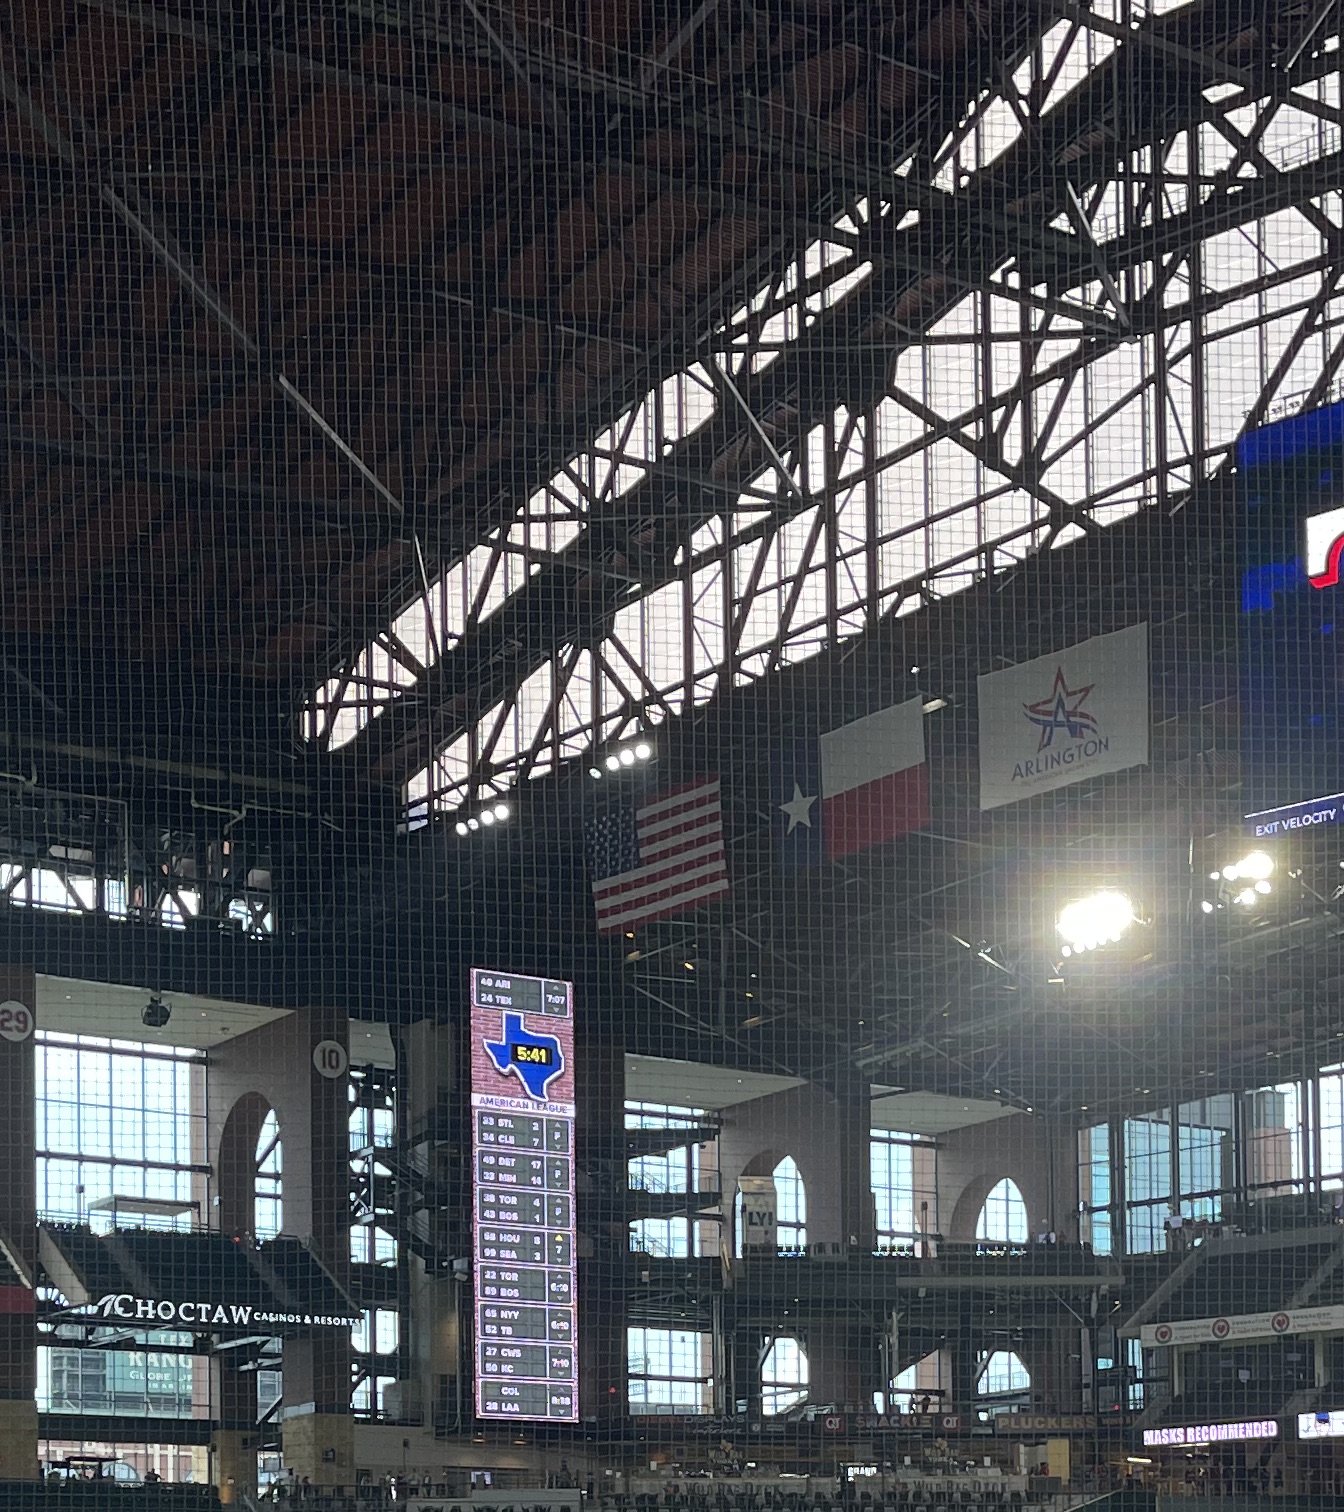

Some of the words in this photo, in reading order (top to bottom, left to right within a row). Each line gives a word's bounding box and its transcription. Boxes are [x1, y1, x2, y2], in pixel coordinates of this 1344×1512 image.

[1011, 736, 1109, 781] ARLINGTON
[1255, 820, 1279, 837] EXIT
[1281, 807, 1337, 832] VELOCITY
[321, 1047, 340, 1071] 10
[517, 1046, 547, 1063] 5:41
[479, 1096, 529, 1110] AMERICAN
[532, 1102, 568, 1113] LEAGUE
[499, 1233, 520, 1243] HOU
[112, 1294, 253, 1325] CHOCTAW
[254, 1311, 300, 1324] CASINOS
[313, 1315, 365, 1327] RESORTS
[998, 1416, 1096, 1429] PLUCKERS
[1143, 1426, 1184, 1446] MASKS
[1186, 1420, 1278, 1443] RECOMMENDED
